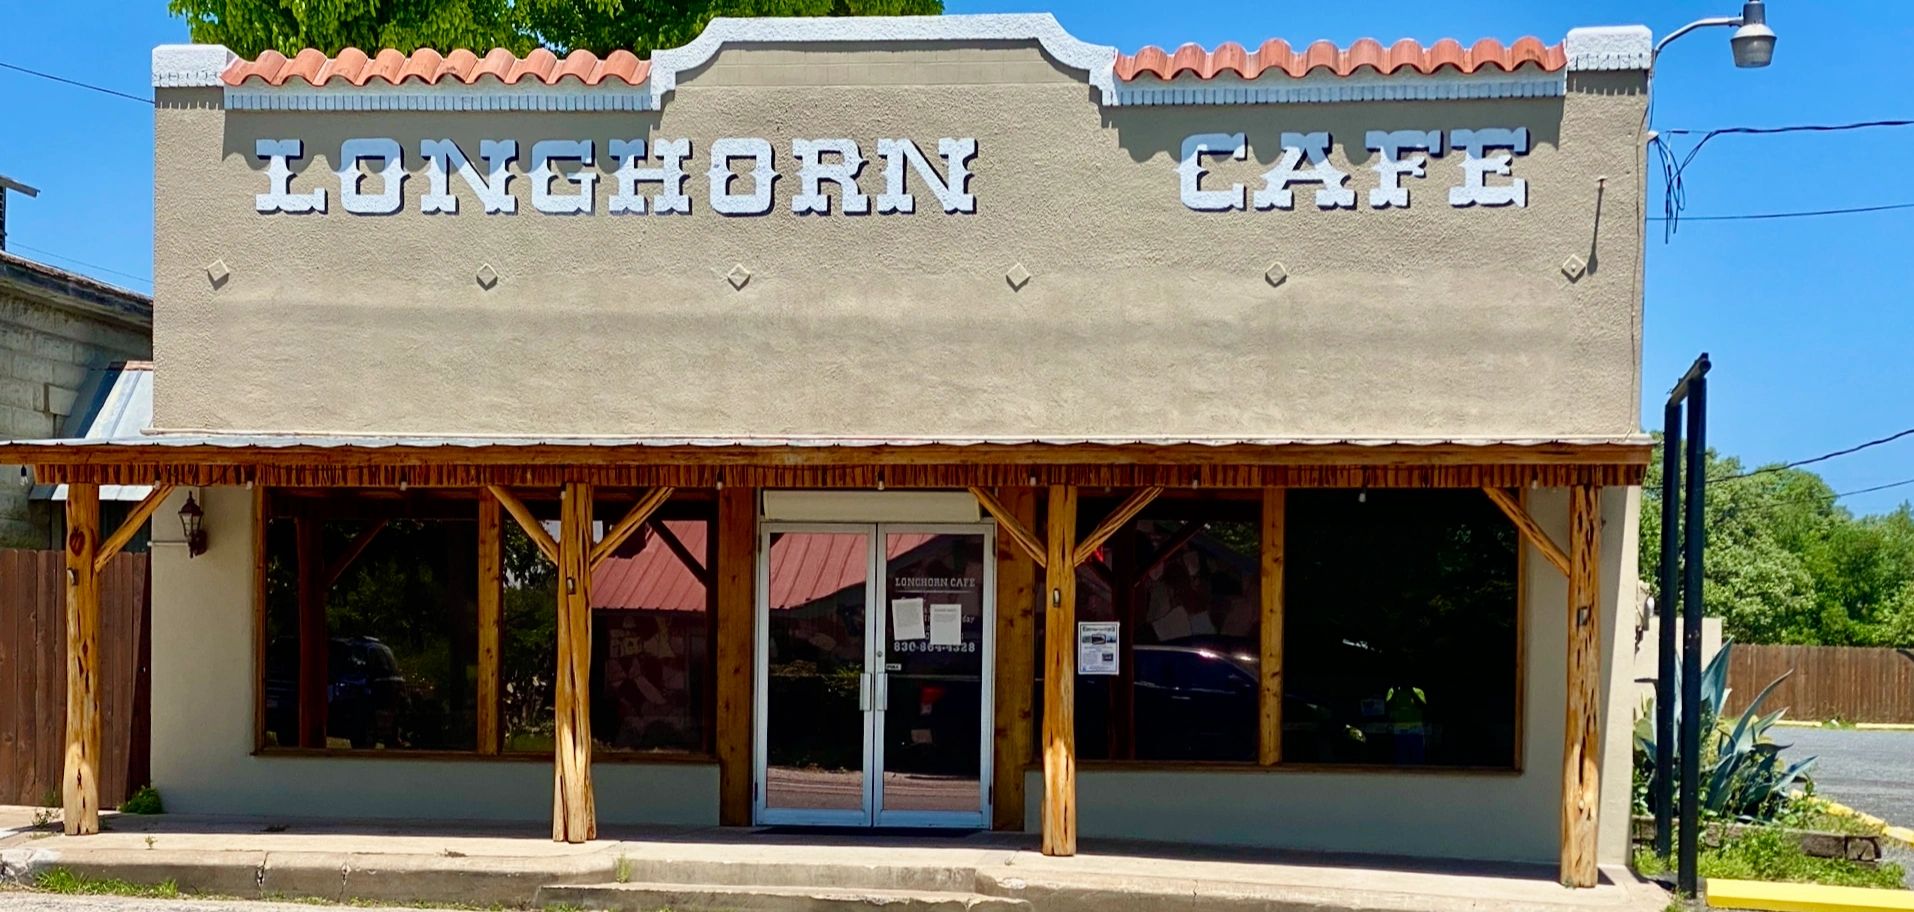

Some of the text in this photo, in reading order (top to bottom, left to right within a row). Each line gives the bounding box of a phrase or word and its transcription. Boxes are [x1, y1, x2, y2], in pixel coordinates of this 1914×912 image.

[256, 127, 1530, 215] LONGHORN CAFE
[895, 577, 975, 587] LONGHORN CAFE
